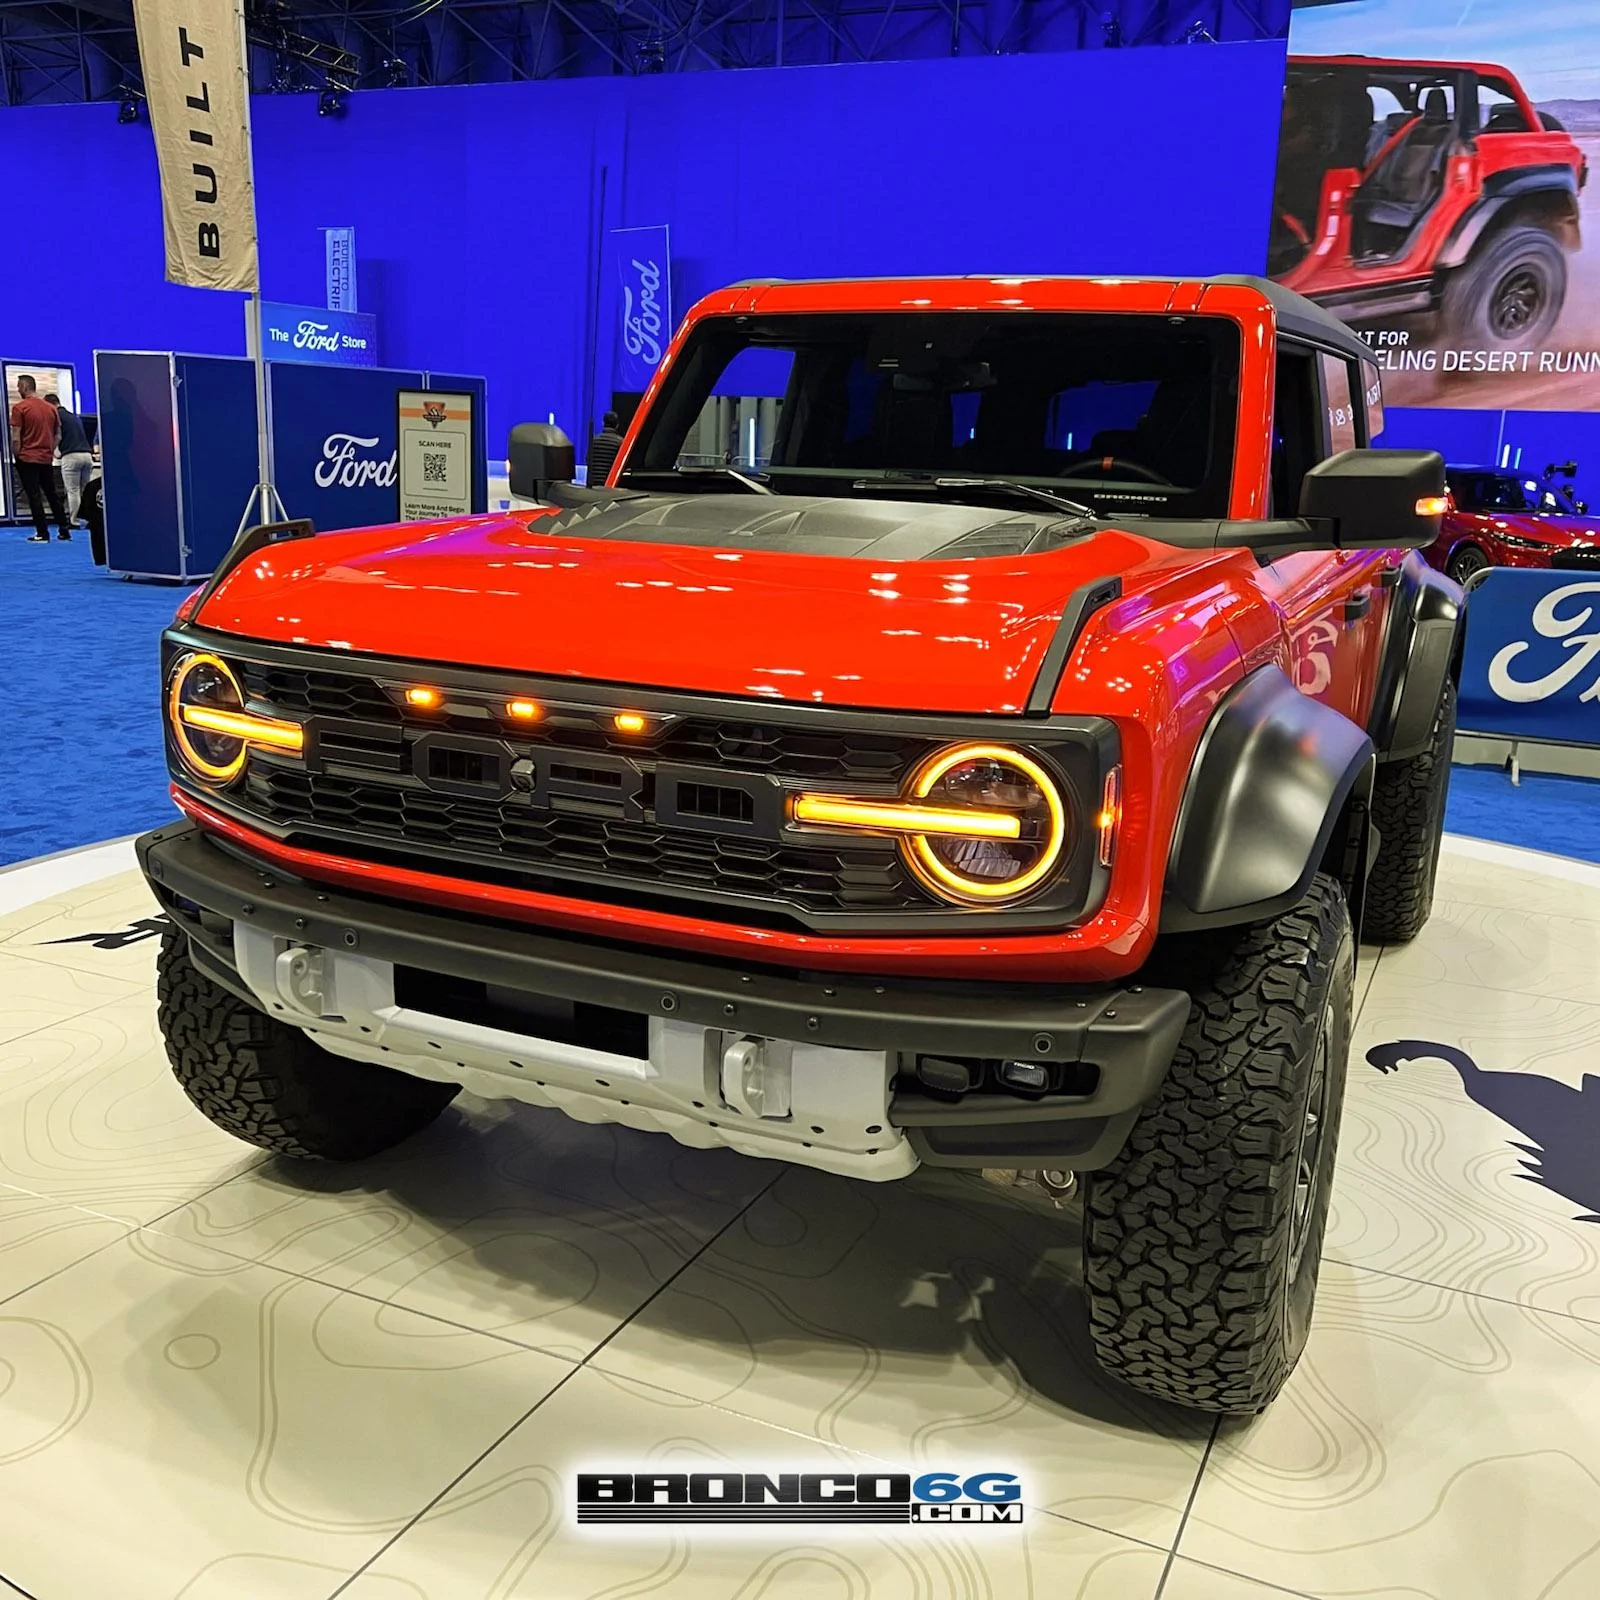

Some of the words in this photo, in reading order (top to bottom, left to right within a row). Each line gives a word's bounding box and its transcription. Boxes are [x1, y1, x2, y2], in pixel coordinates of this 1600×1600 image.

[178, 26, 220, 258] BUILT
[341, 240, 349, 271] BUILT
[624, 258, 662, 365] Ford
[269, 328, 289, 342] The
[293, 320, 340, 352] Ford
[341, 335, 367, 349] Store
[1378, 331, 1409, 345] FOR
[1442, 350, 1533, 372] DESERT
[418, 440, 435, 449] SCAN
[435, 441, 451, 449] HERE
[314, 433, 397, 488] Ford
